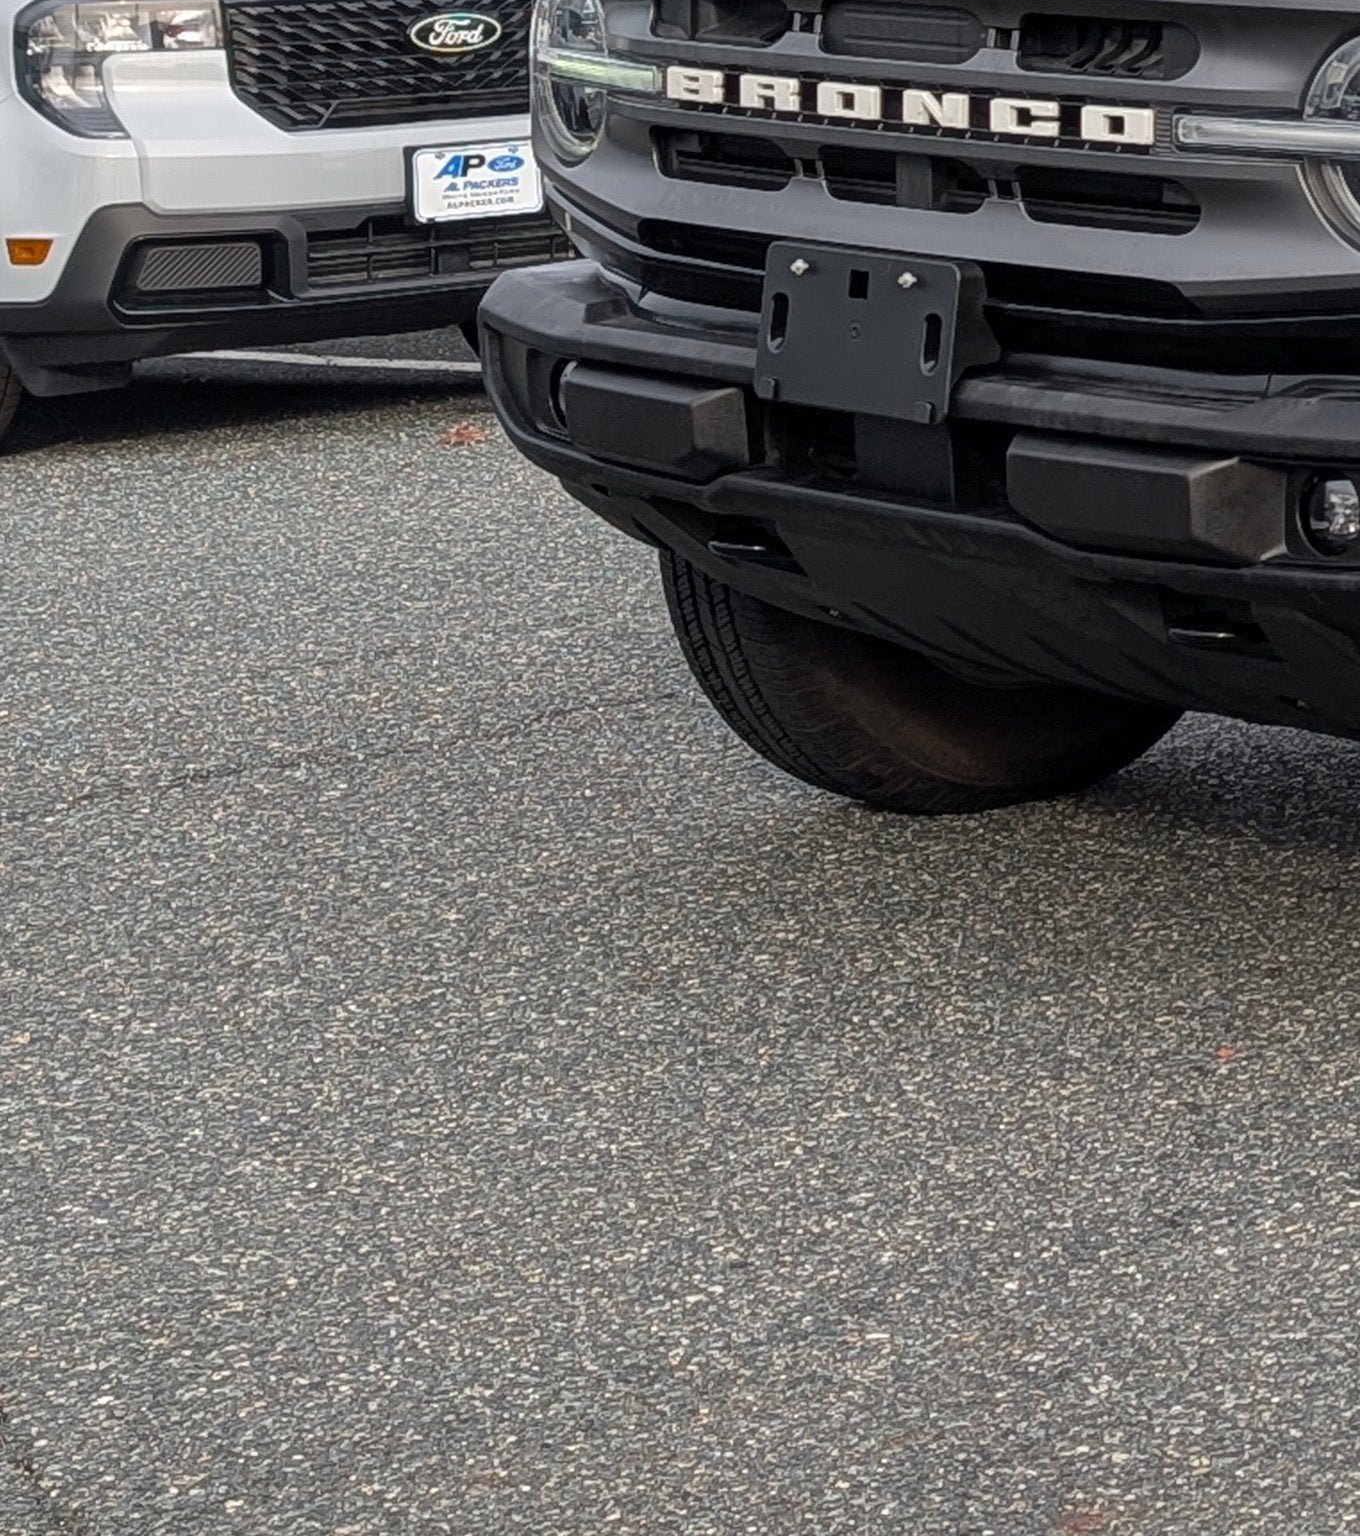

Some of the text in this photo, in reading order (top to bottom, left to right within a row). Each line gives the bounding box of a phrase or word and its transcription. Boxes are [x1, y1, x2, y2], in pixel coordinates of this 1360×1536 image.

[429, 18, 485, 46] Ford
[666, 65, 1156, 146] BRONCO
[433, 154, 486, 180] AP
